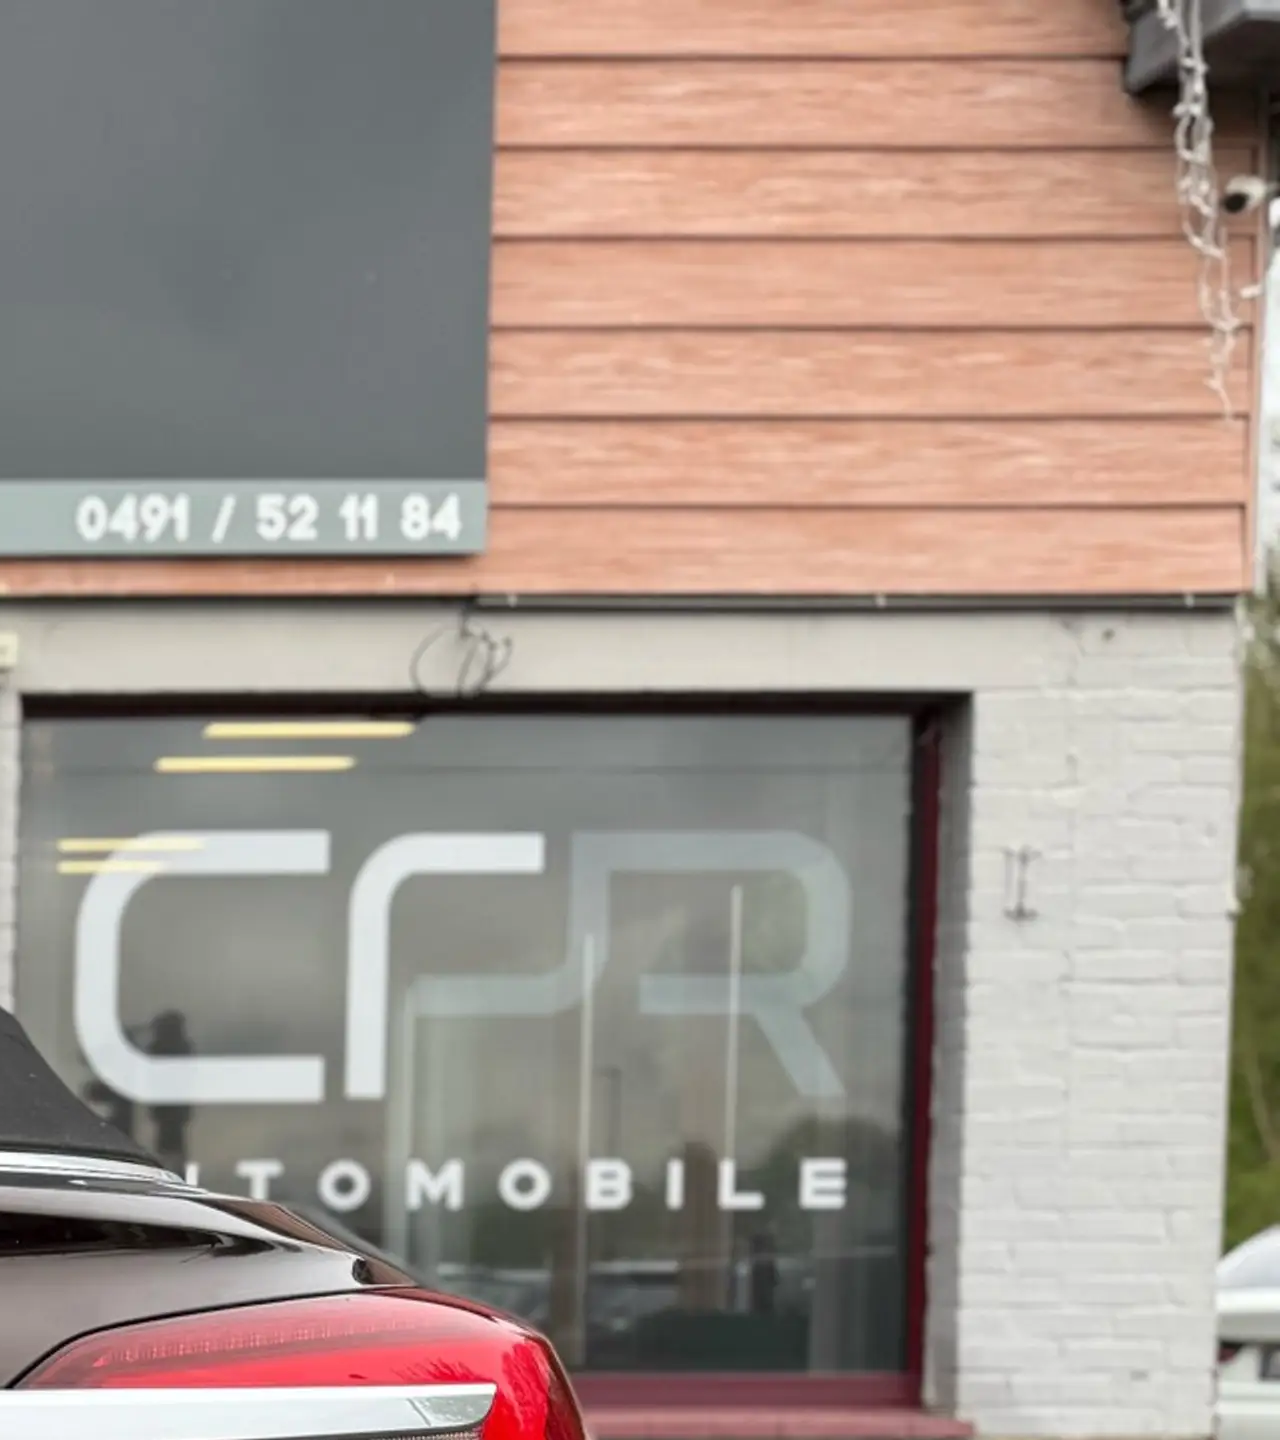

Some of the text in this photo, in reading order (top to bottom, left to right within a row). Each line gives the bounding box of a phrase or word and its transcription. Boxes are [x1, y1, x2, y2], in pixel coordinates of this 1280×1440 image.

[76, 493, 189, 542] 0491
[255, 493, 319, 541] 52
[339, 493, 379, 541] 11
[400, 493, 461, 541] 84
[74, 829, 852, 1104] CPR
[185, 1158, 847, 1211] TOMOBILE
